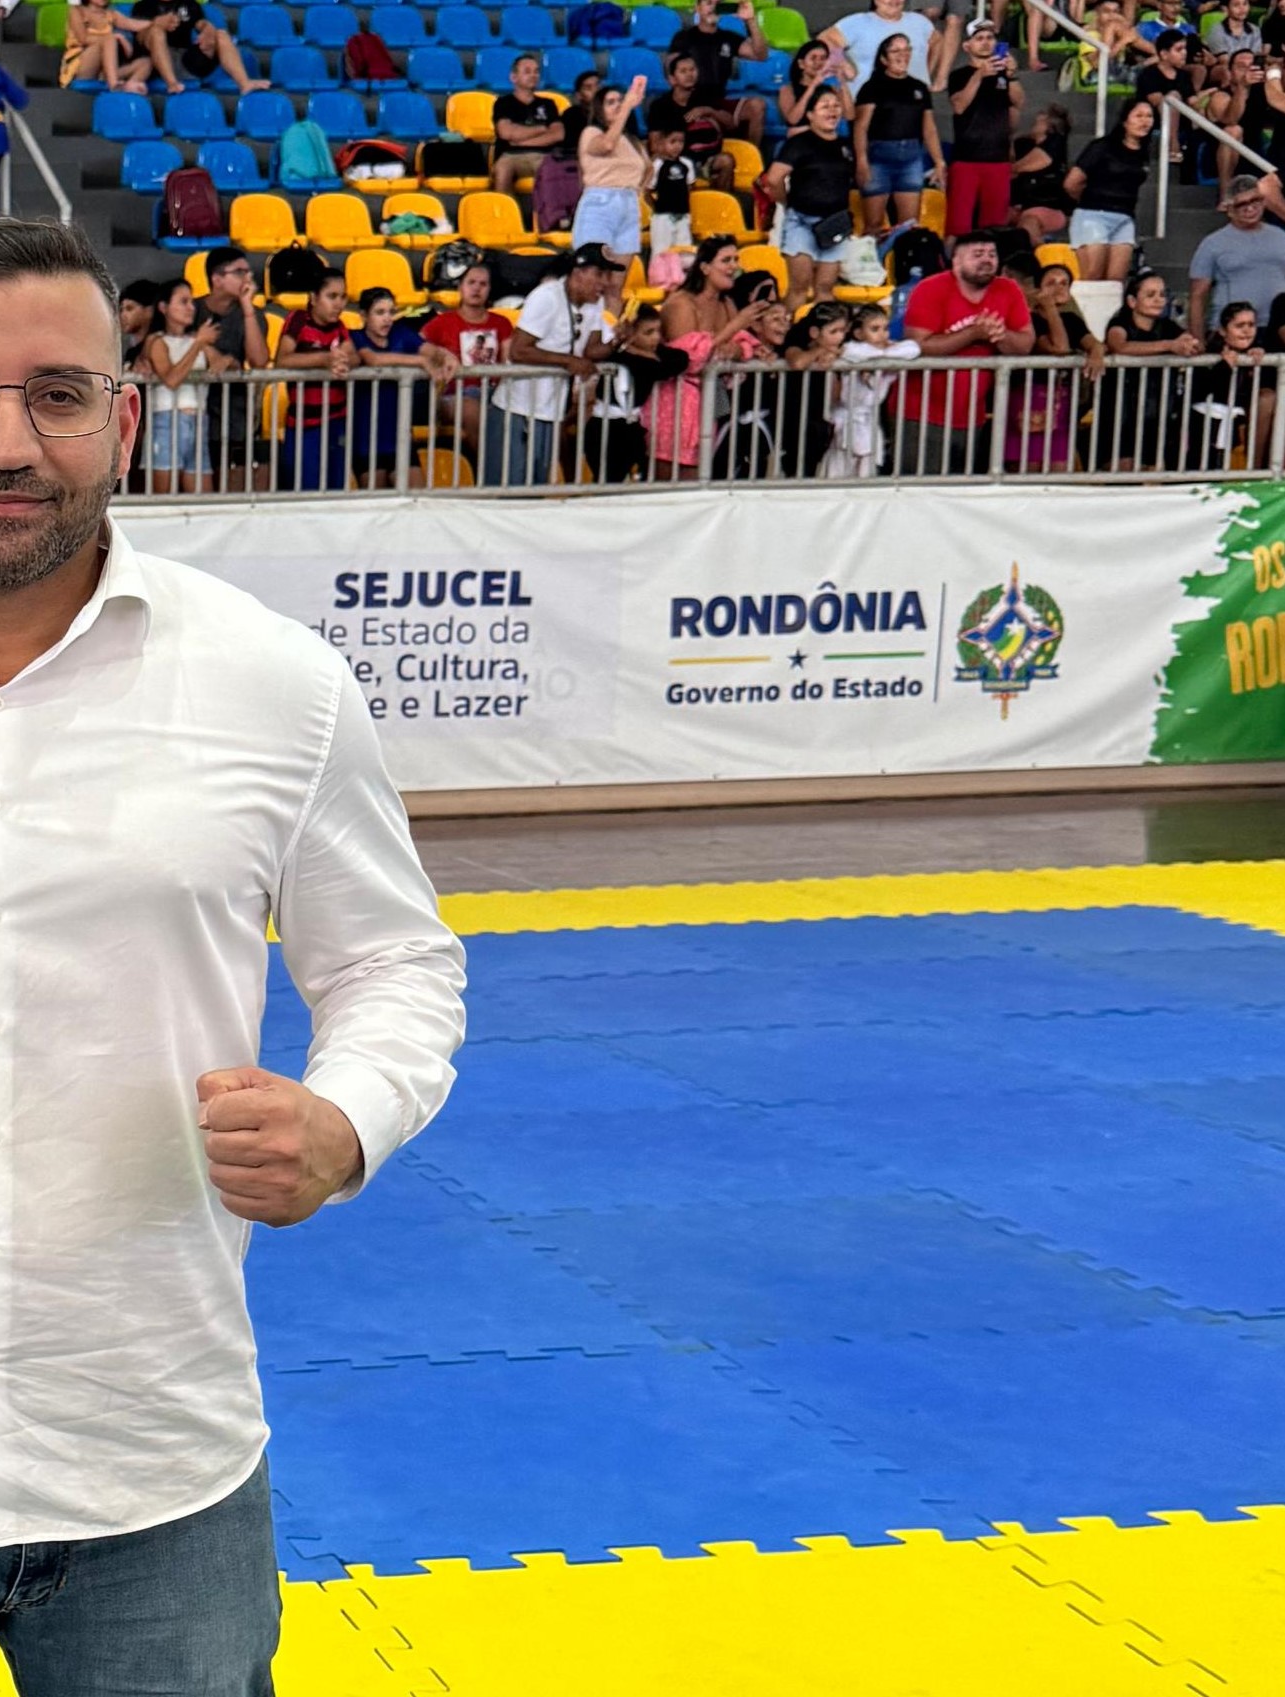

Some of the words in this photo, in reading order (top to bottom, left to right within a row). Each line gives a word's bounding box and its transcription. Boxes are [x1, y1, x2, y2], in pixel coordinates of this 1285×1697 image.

[333, 570, 533, 610] SEJUCEL
[669, 580, 927, 639] RONDÔNIA
[361, 615, 478, 647] Estado
[488, 614, 530, 645] da
[396, 652, 530, 686] Cultura,
[400, 695, 420, 720] e
[433, 689, 530, 719] Lazer
[666, 682, 781, 706] Governo
[790, 679, 824, 701] do
[832, 675, 924, 699] Estado
